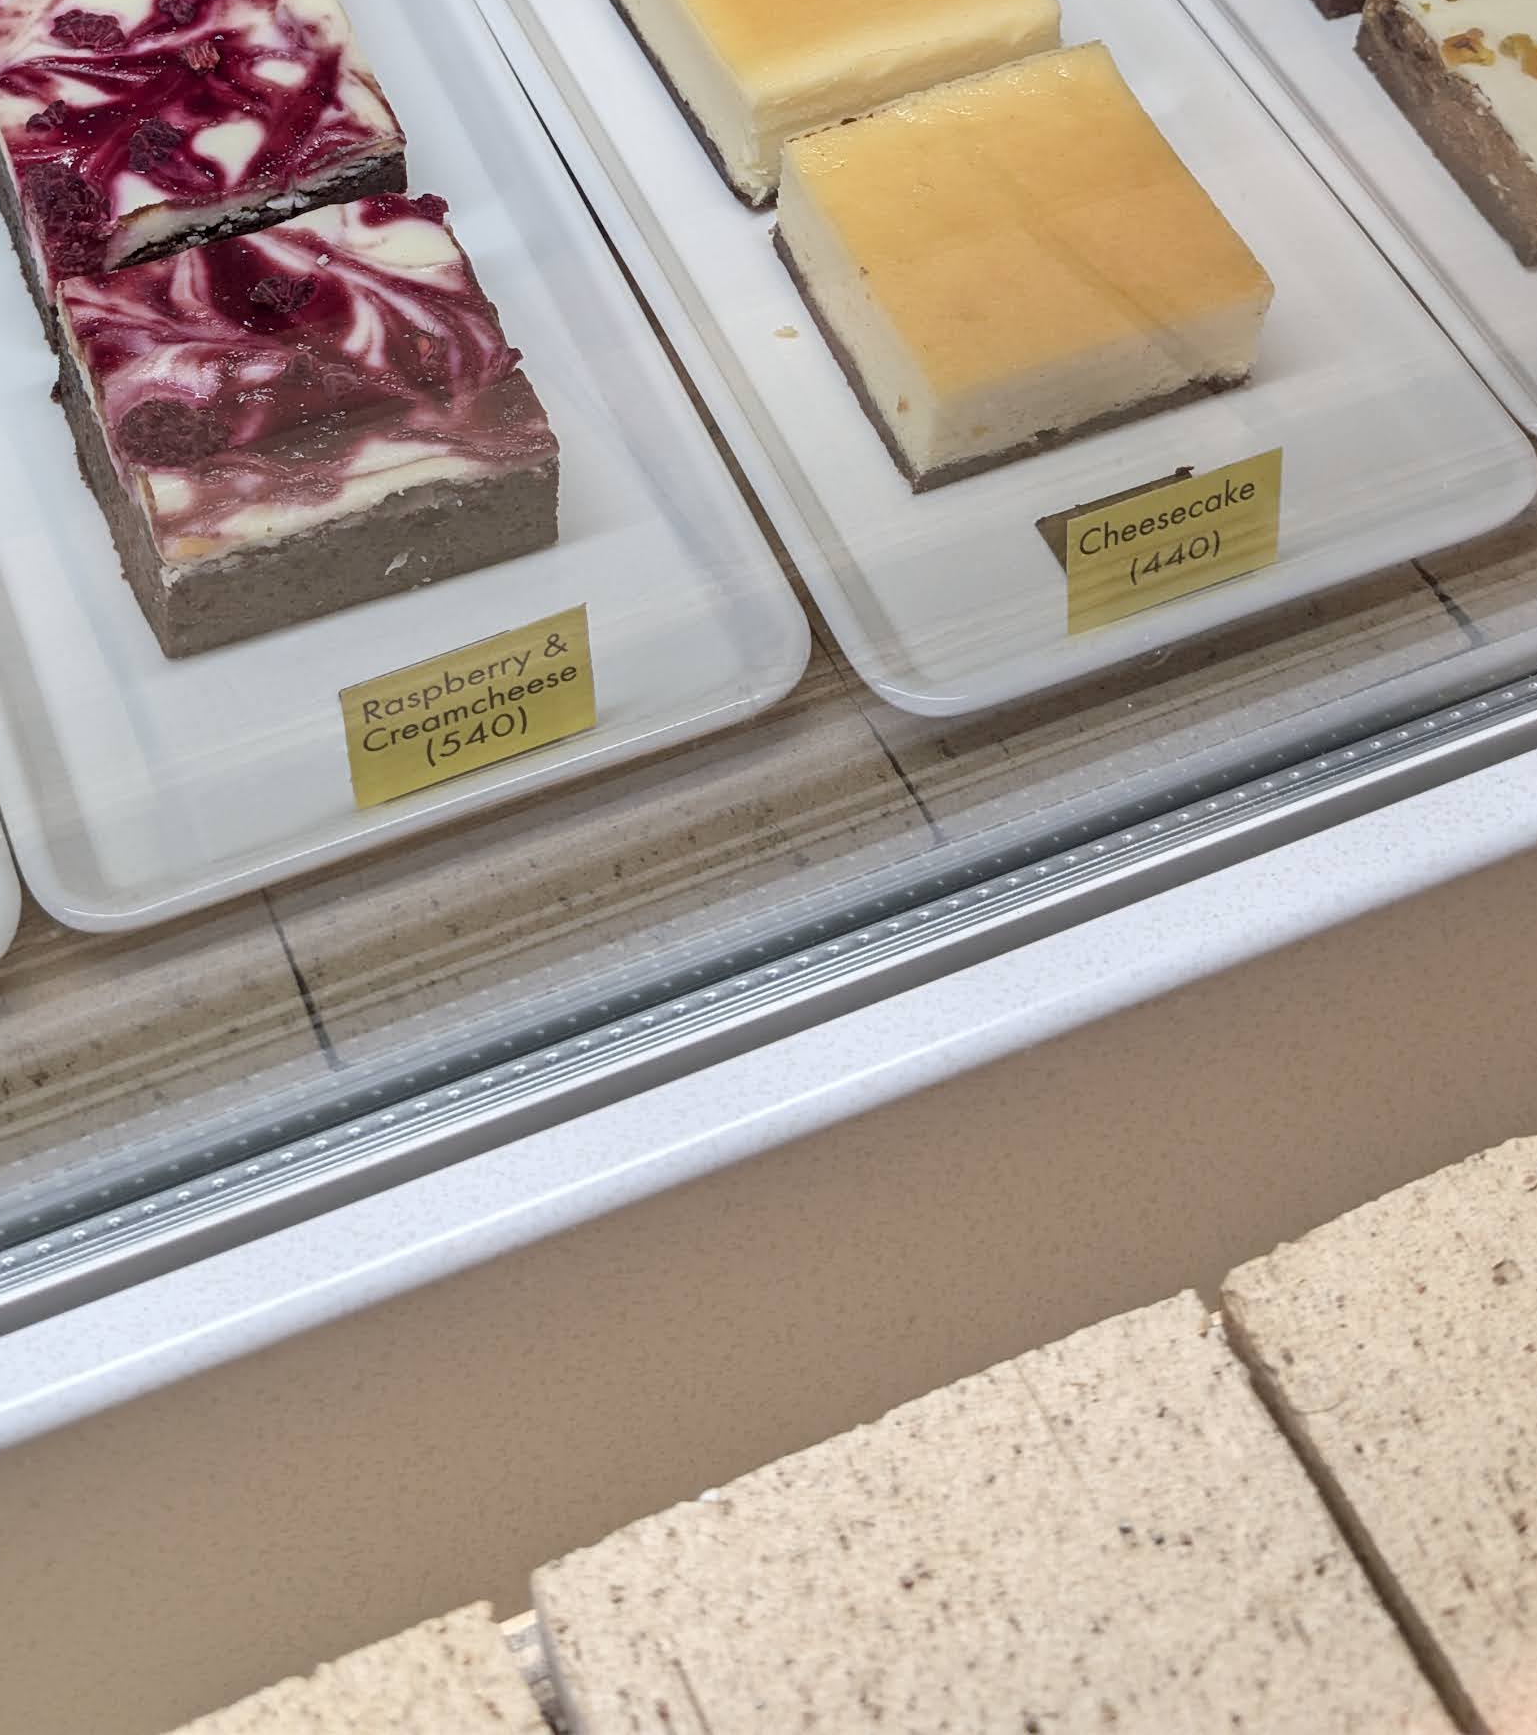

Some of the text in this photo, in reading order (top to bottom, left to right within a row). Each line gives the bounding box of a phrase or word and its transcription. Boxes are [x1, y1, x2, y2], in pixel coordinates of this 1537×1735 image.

[1079, 479, 1255, 555] Cheesecake
[1129, 530, 1220, 585] (440)
[362, 633, 568, 723] Raspberry &
[363, 666, 577, 752] Creamcheese
[426, 706, 527, 767] (540)
